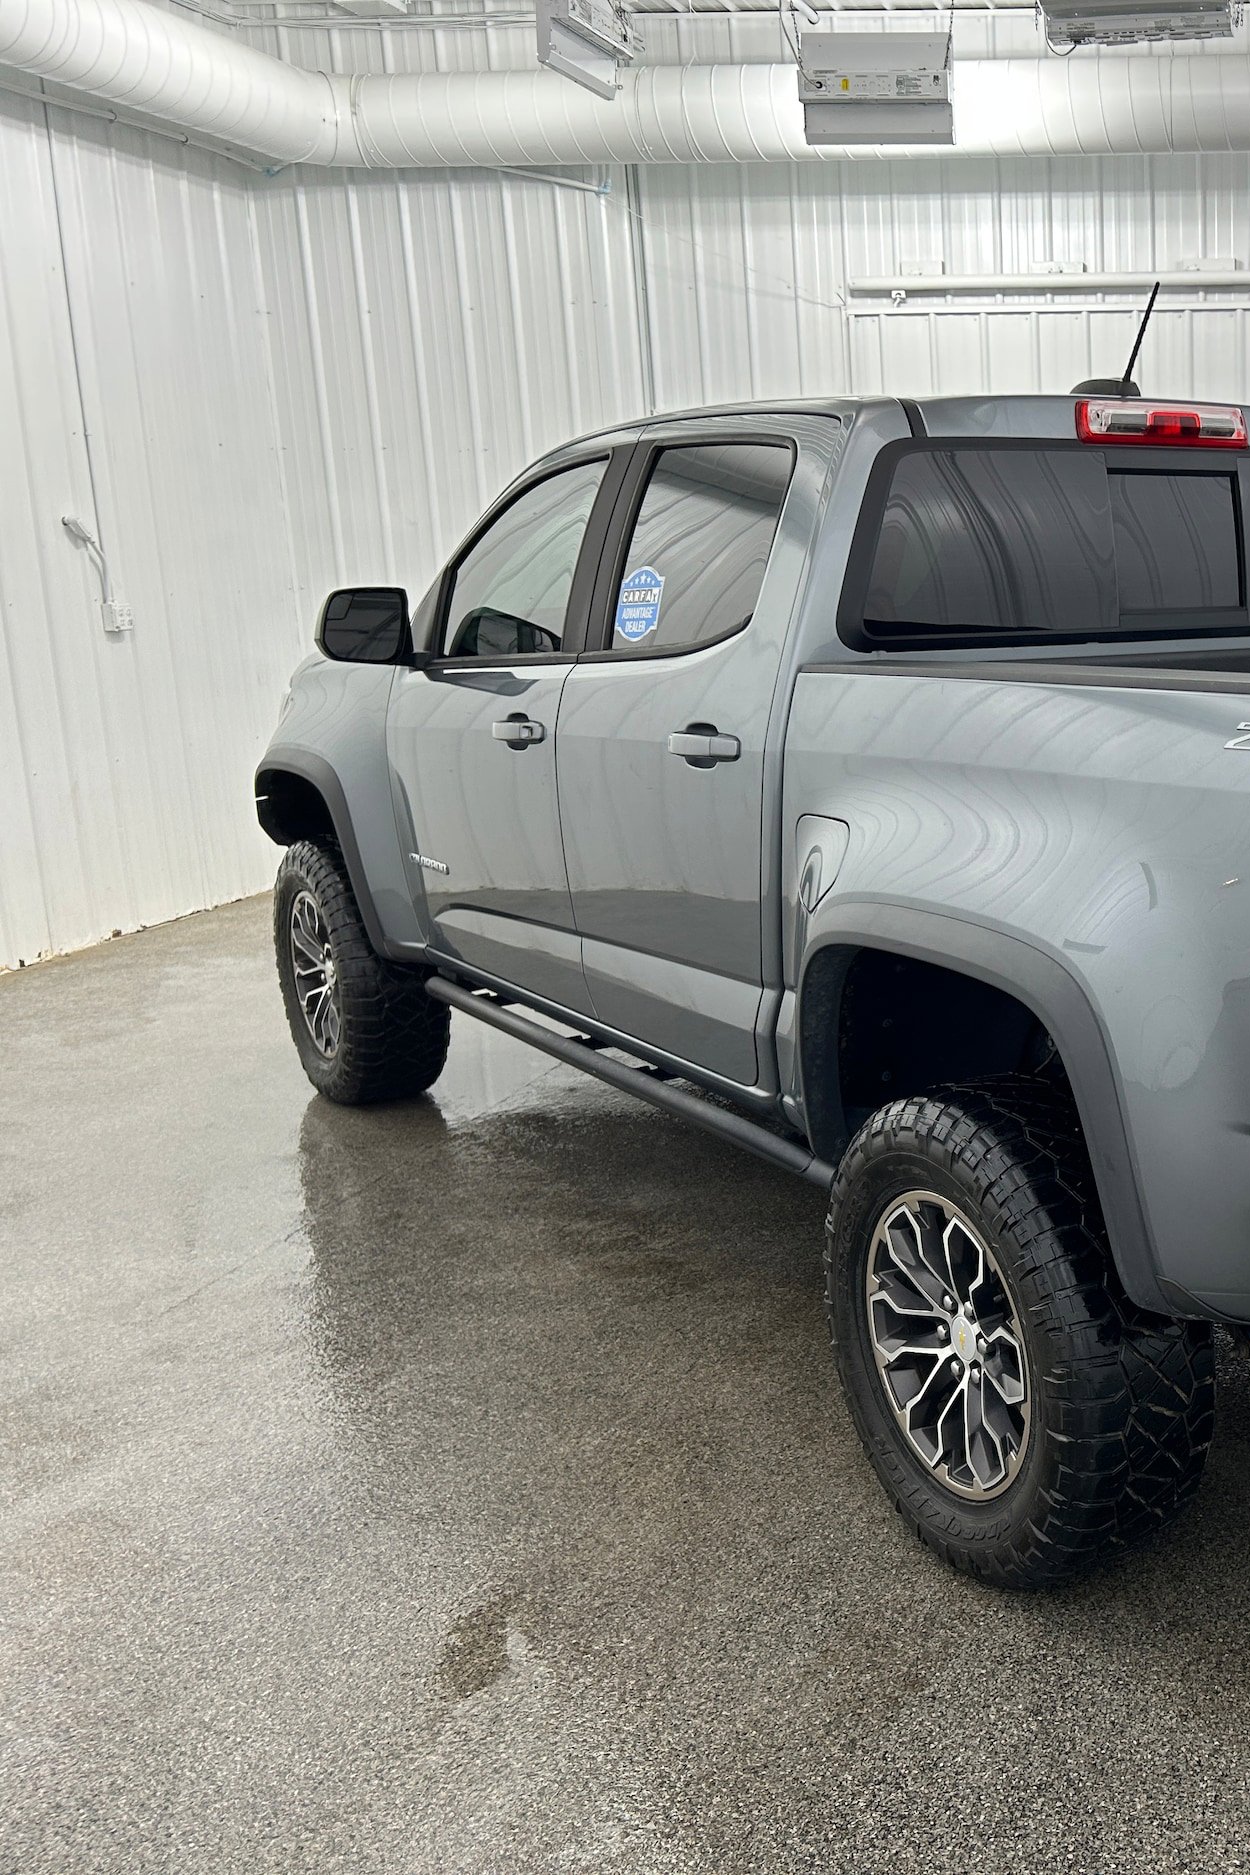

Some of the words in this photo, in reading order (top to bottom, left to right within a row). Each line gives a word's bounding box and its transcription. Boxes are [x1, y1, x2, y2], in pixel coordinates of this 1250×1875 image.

[622, 588, 660, 604] CARFAX
[622, 607, 654, 619] ADVANTAGE
[625, 620, 646, 632] DEALER
